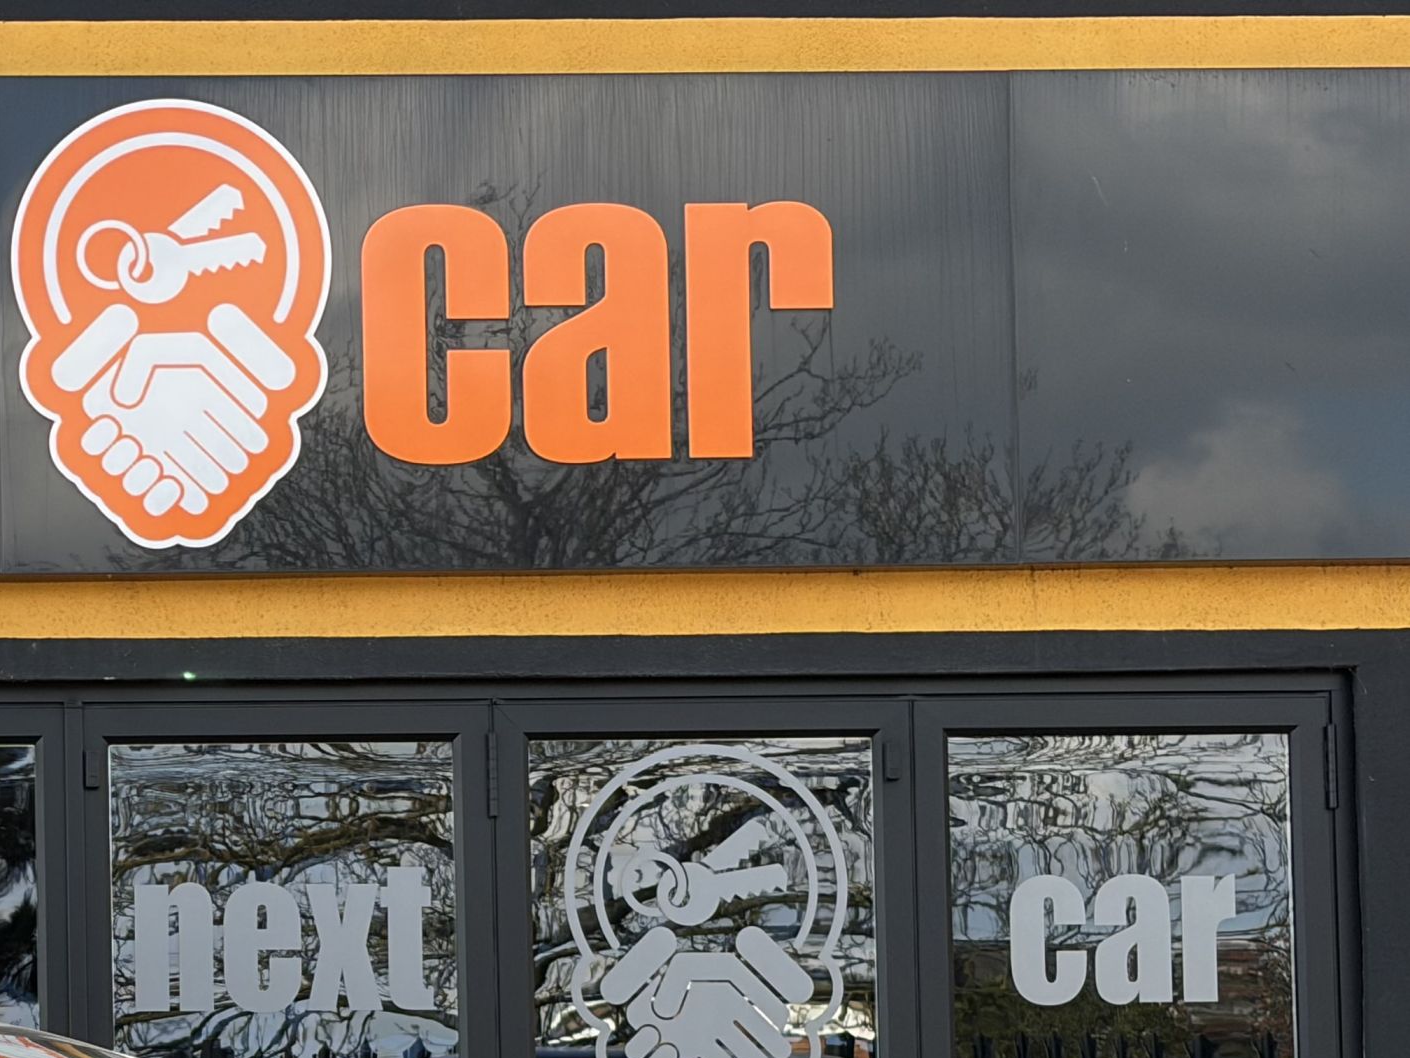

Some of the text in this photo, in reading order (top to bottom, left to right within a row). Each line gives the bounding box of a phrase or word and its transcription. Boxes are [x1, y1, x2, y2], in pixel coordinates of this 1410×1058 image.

[362, 202, 834, 464] car
[134, 866, 435, 1013] next
[1010, 873, 1238, 1006] car
